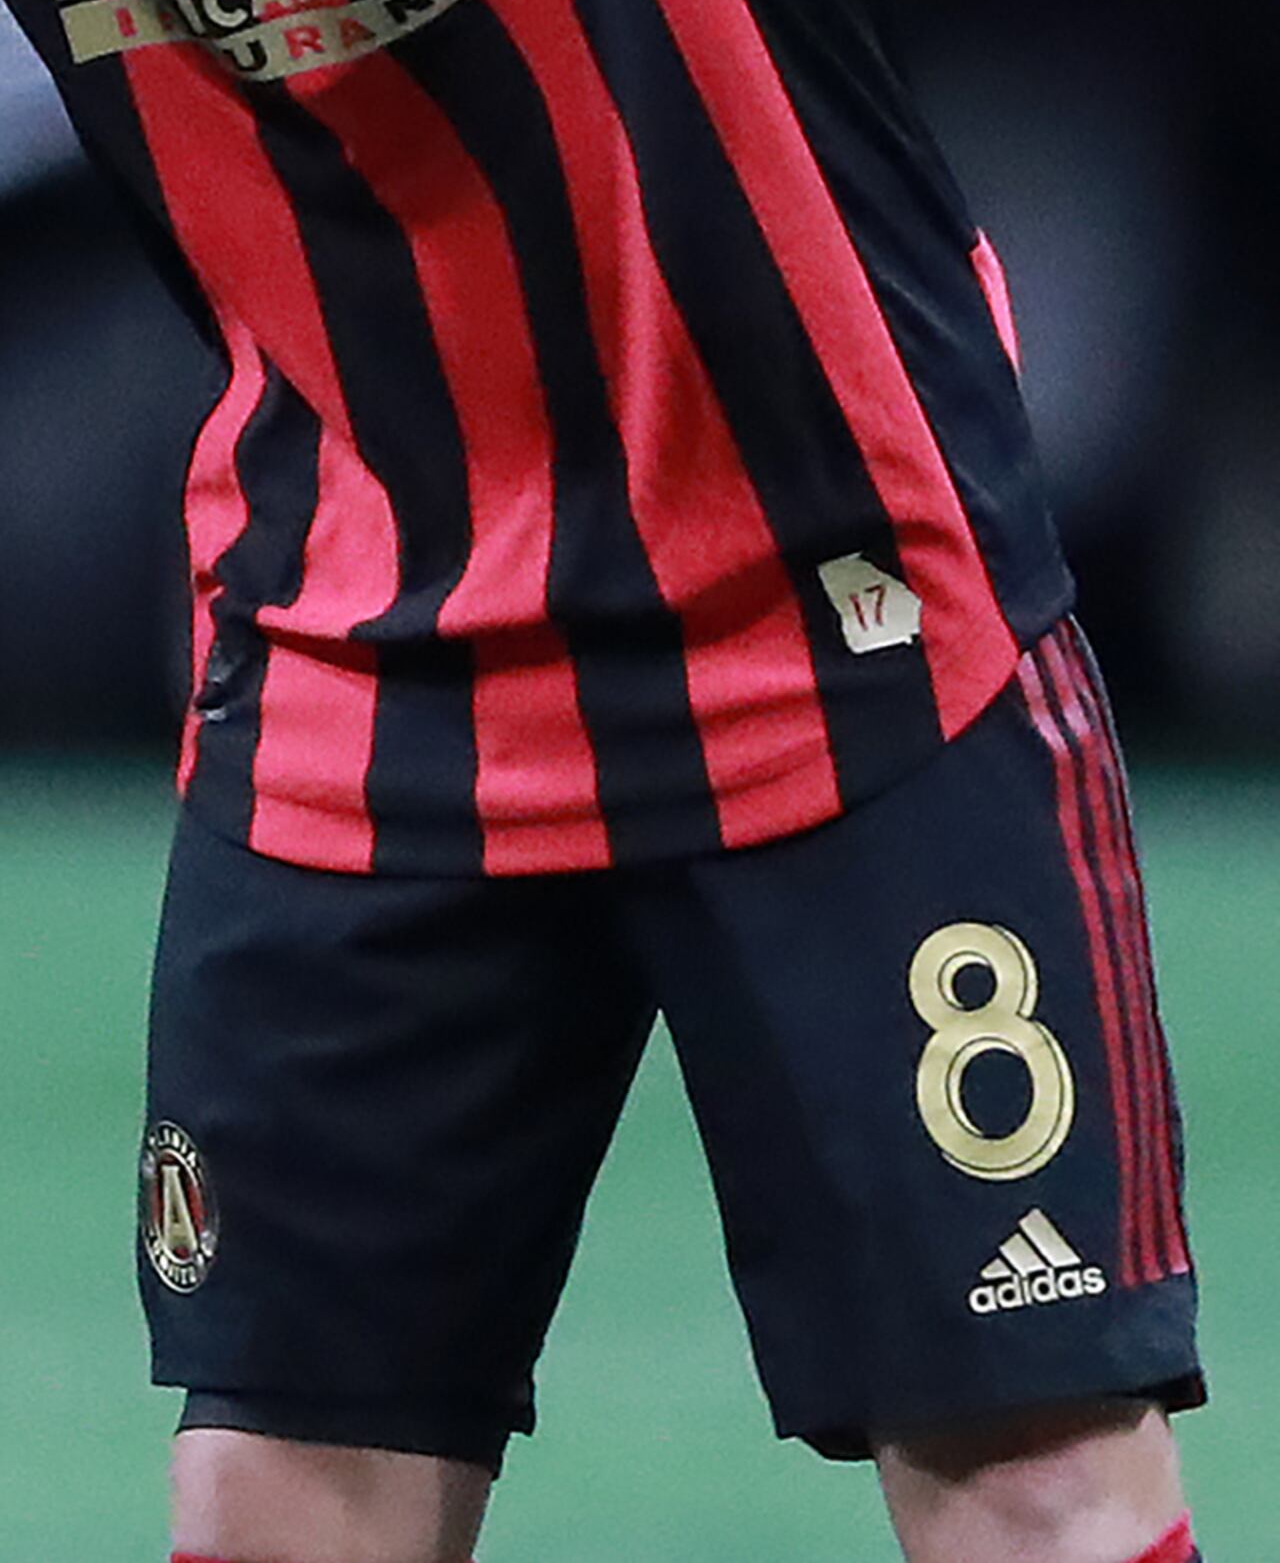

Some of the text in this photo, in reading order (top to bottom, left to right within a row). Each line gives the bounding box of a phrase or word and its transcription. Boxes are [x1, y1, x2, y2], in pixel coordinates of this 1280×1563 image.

[848, 582, 887, 632] 17
[908, 920, 1075, 1181] 8
[968, 1265, 1107, 1314] adidas
